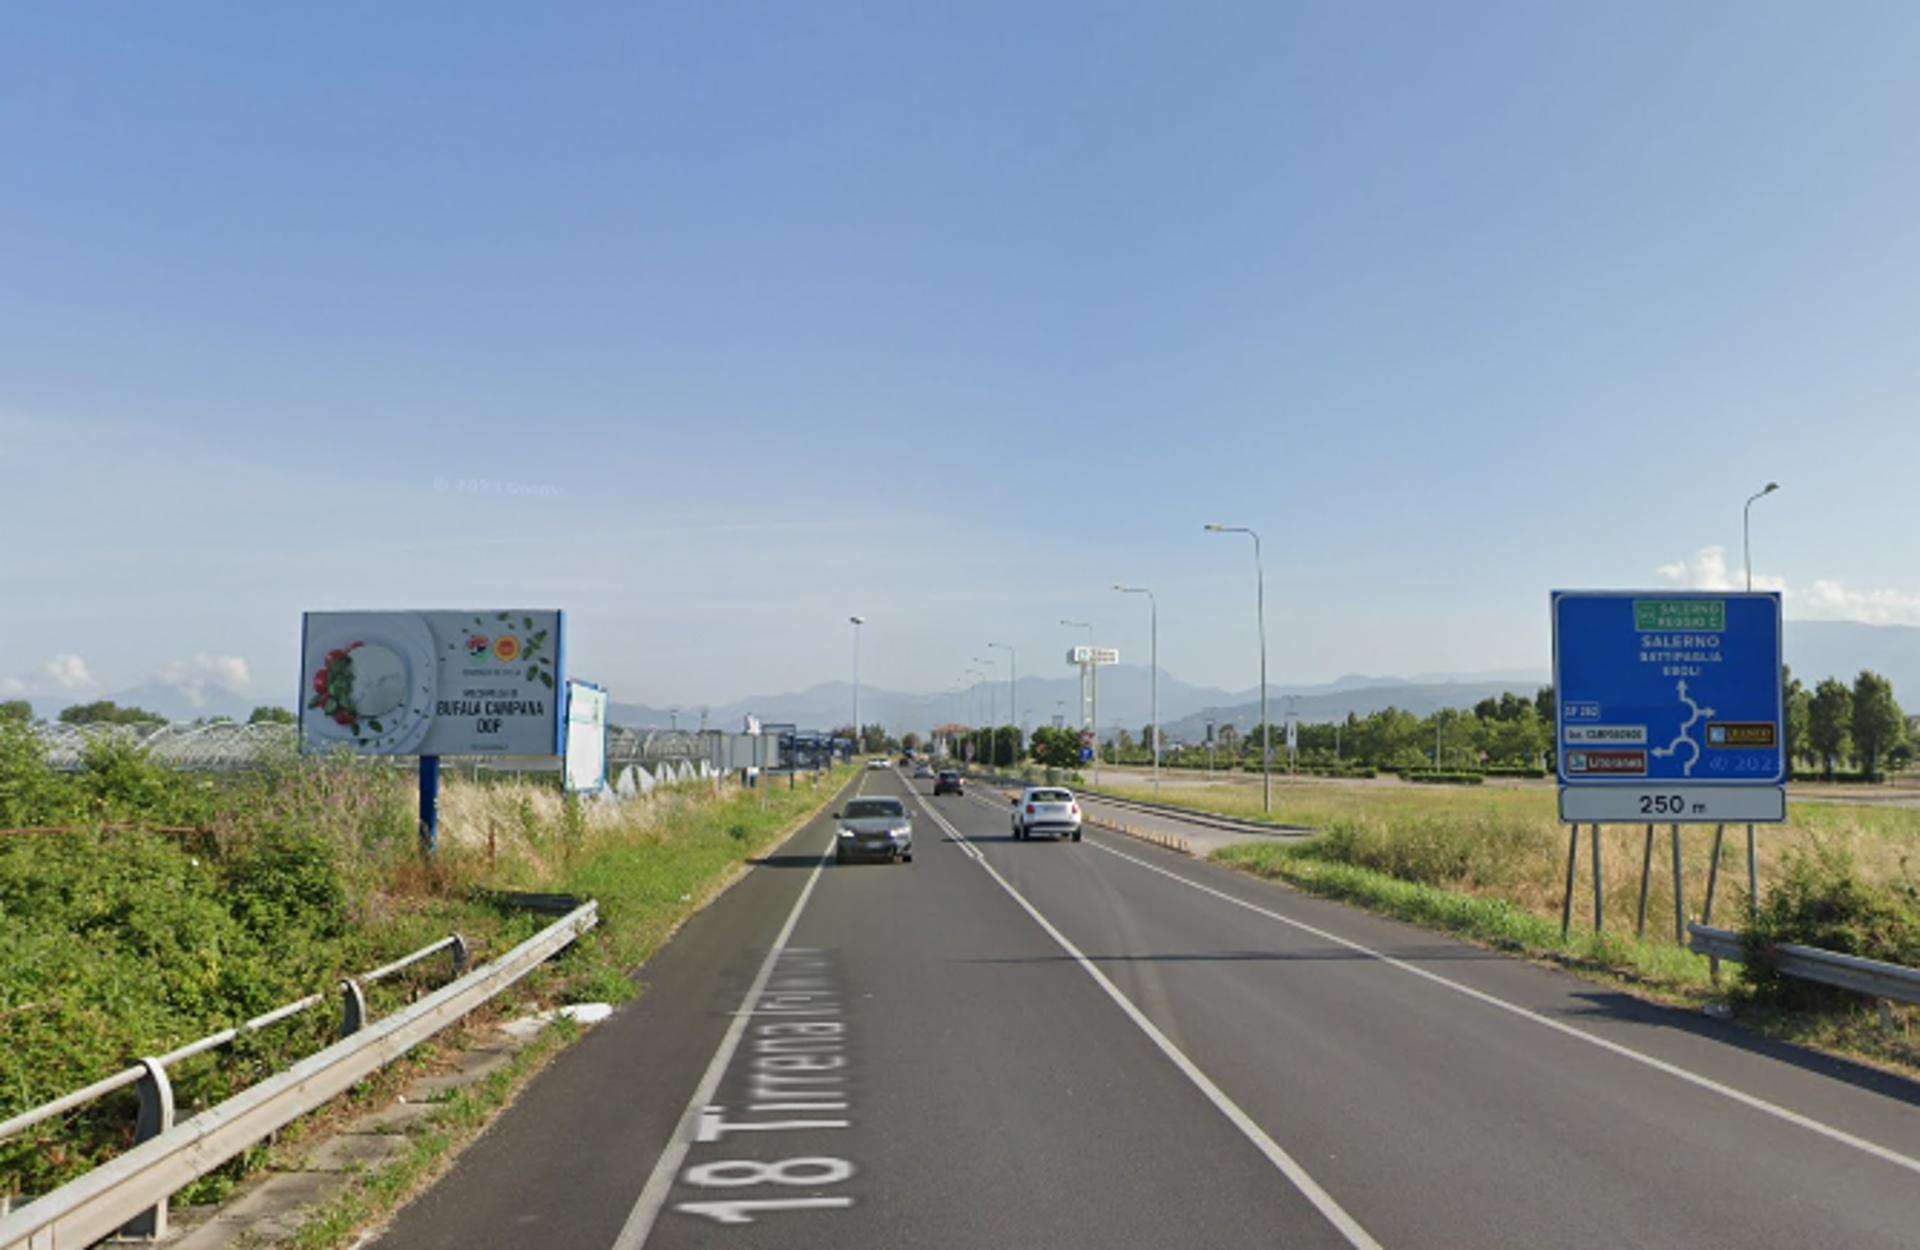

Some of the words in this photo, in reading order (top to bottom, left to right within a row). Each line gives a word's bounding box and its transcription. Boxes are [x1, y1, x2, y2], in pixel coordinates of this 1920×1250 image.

[1641, 634, 1720, 648] SALERNO
[1639, 651, 1722, 662] BATTIPAGLIA
[1662, 665, 1701, 677] EBOLI
[436, 700, 481, 717] BUFALA
[485, 700, 544, 717] CAMPANA
[1639, 795, 1685, 815] 250
[1691, 802, 1707, 814] m
